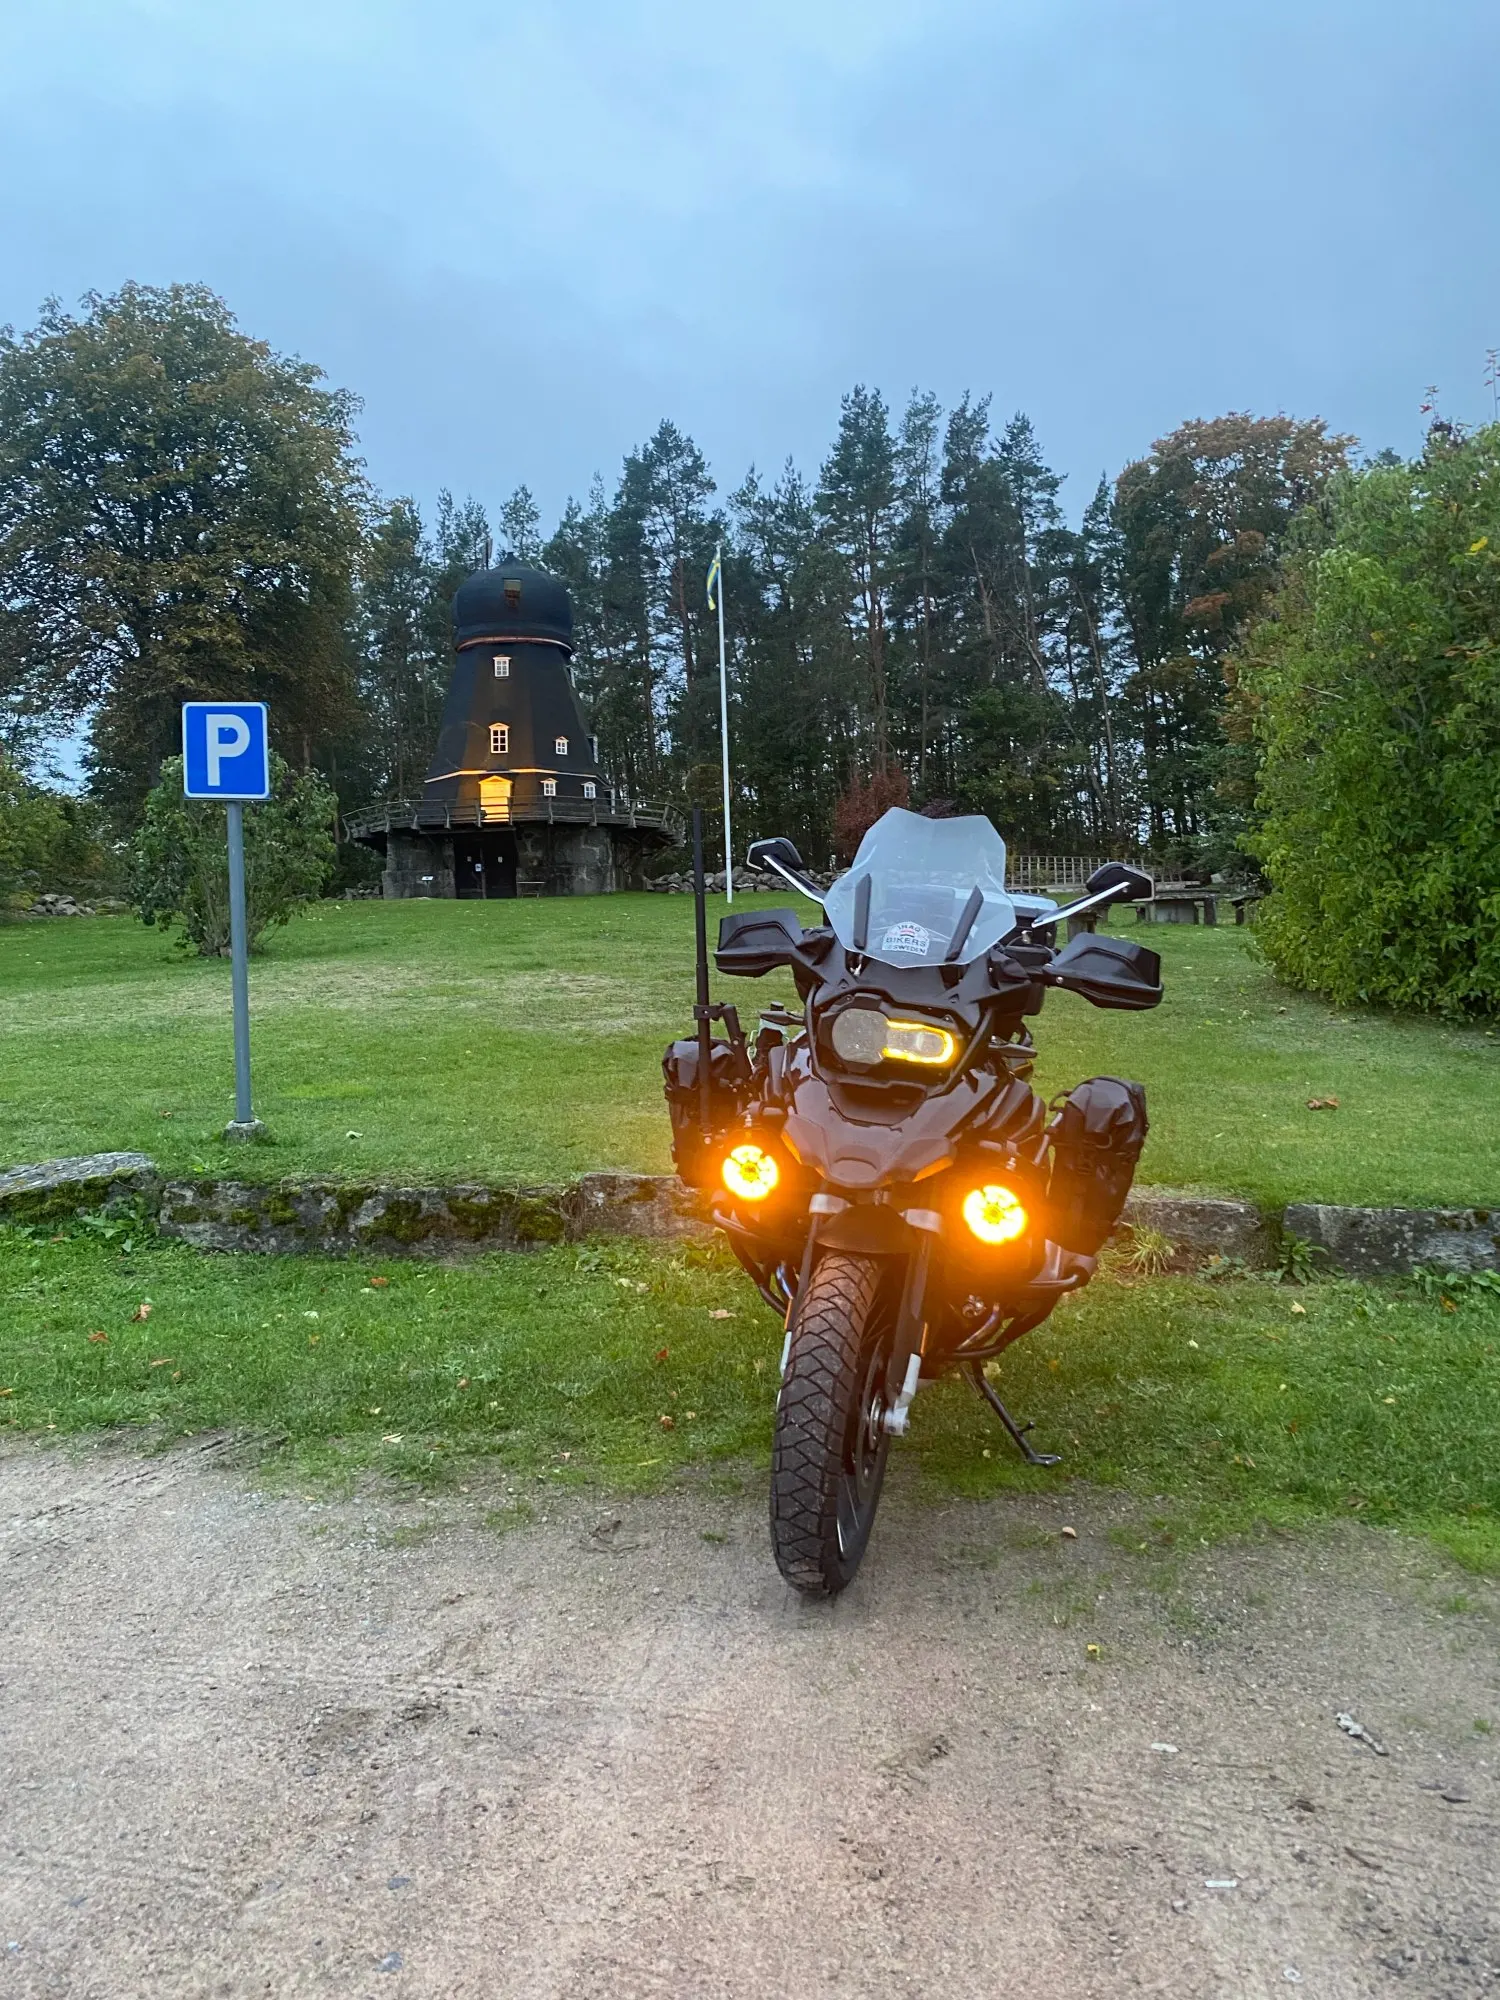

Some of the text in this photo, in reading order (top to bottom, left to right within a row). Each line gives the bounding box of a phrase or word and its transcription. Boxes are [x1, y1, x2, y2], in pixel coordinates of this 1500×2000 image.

[206, 714, 250, 786] P
[886, 937, 926, 947] BIKERS
[892, 945, 926, 954] SWEDEN
